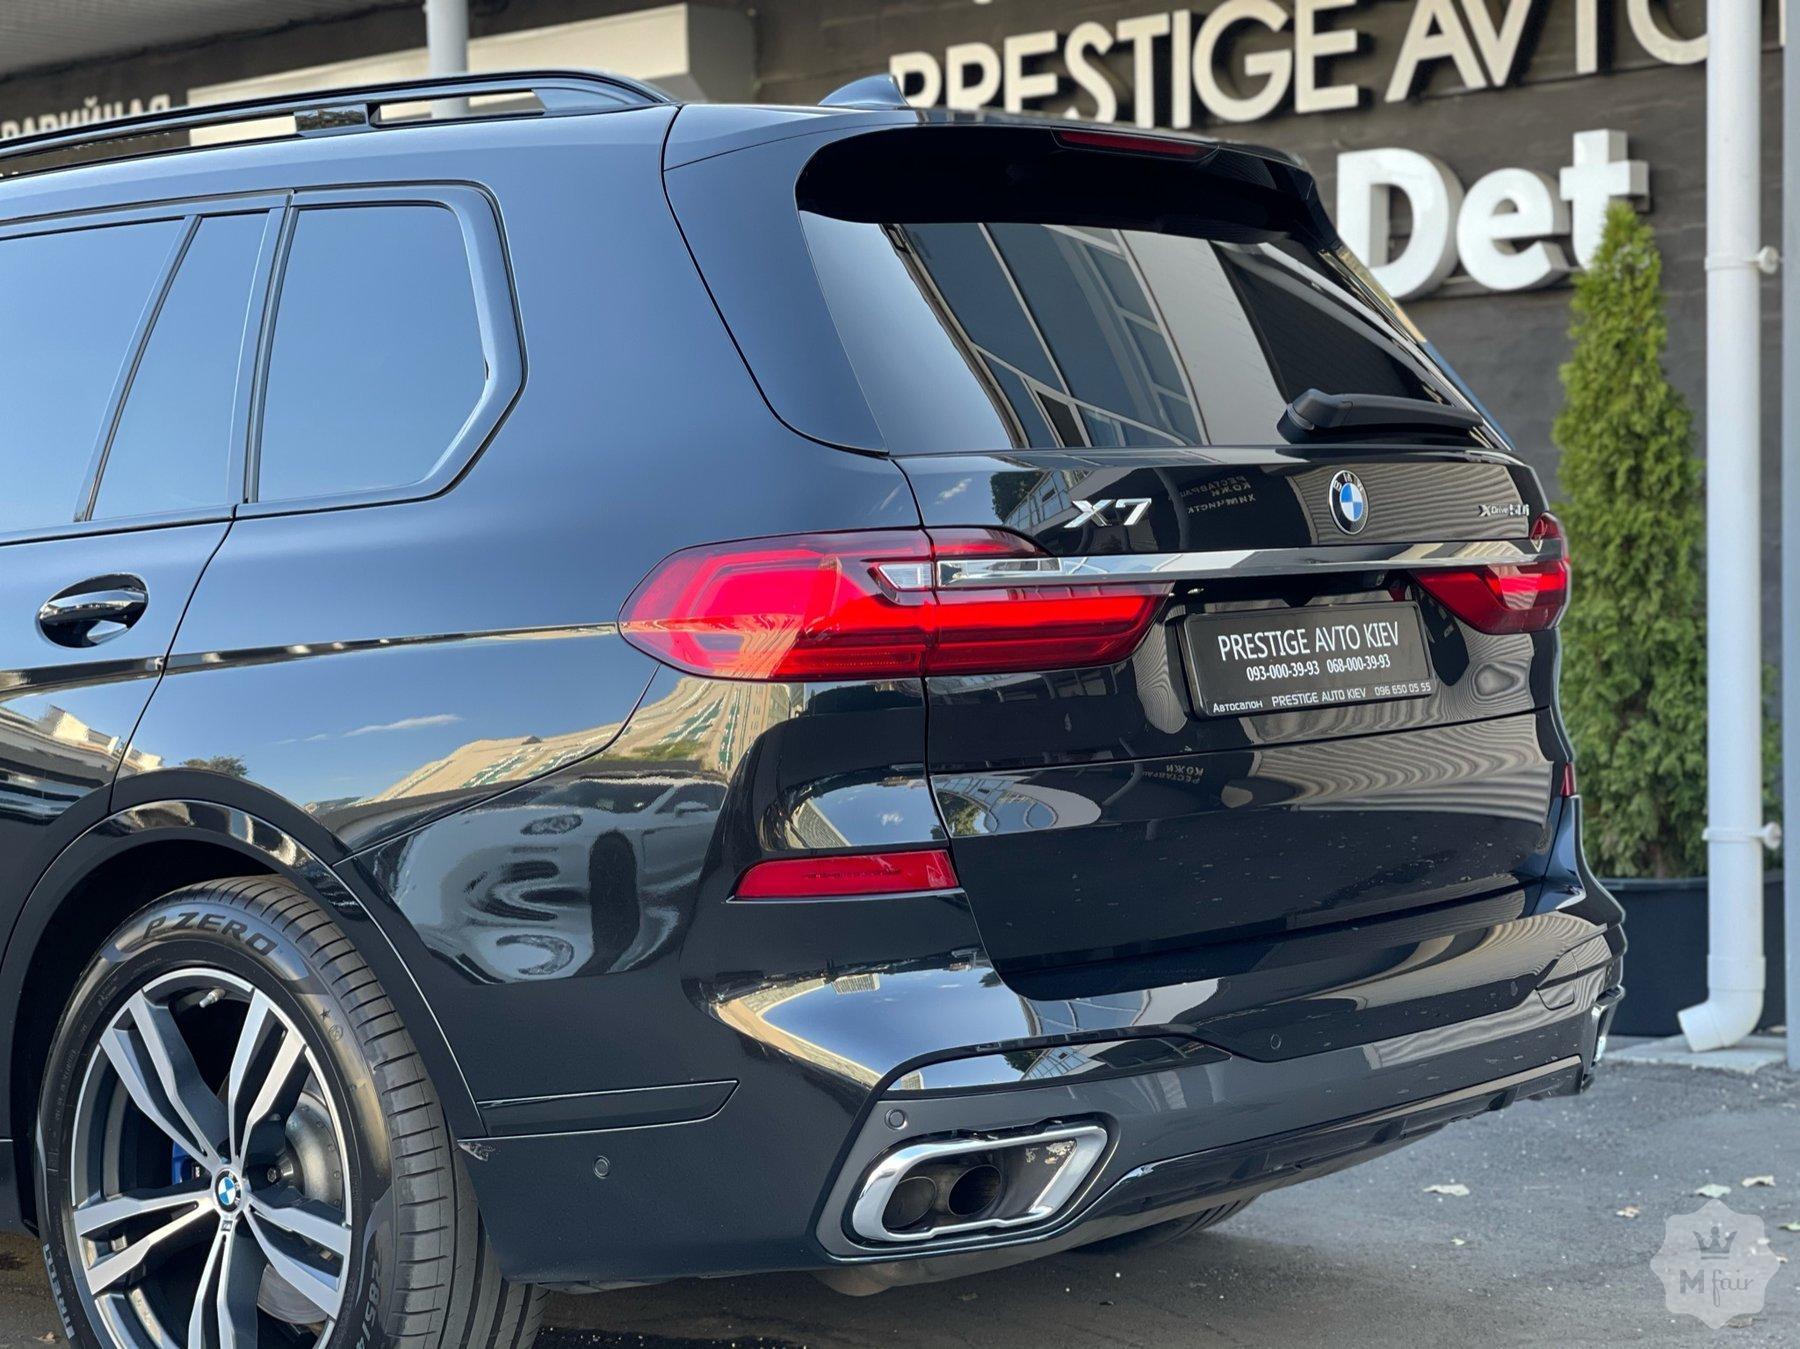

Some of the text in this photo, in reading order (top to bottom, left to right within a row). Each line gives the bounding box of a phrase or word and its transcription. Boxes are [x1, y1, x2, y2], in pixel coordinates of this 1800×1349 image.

[889, 0, 1358, 129] PRESTIGE
[1337, 129, 1648, 300] Det
[1064, 497, 1152, 529] X7
[1217, 621, 1399, 661] PRESTIGE AVTO KIEV
[1246, 654, 1391, 682] 093-000-39-93 068-000-39-93
[1213, 682, 1432, 713] Автосалон PRESTIGE AUTO KIEV 096 650 05 55
[142, 911, 278, 957] P ZERO
